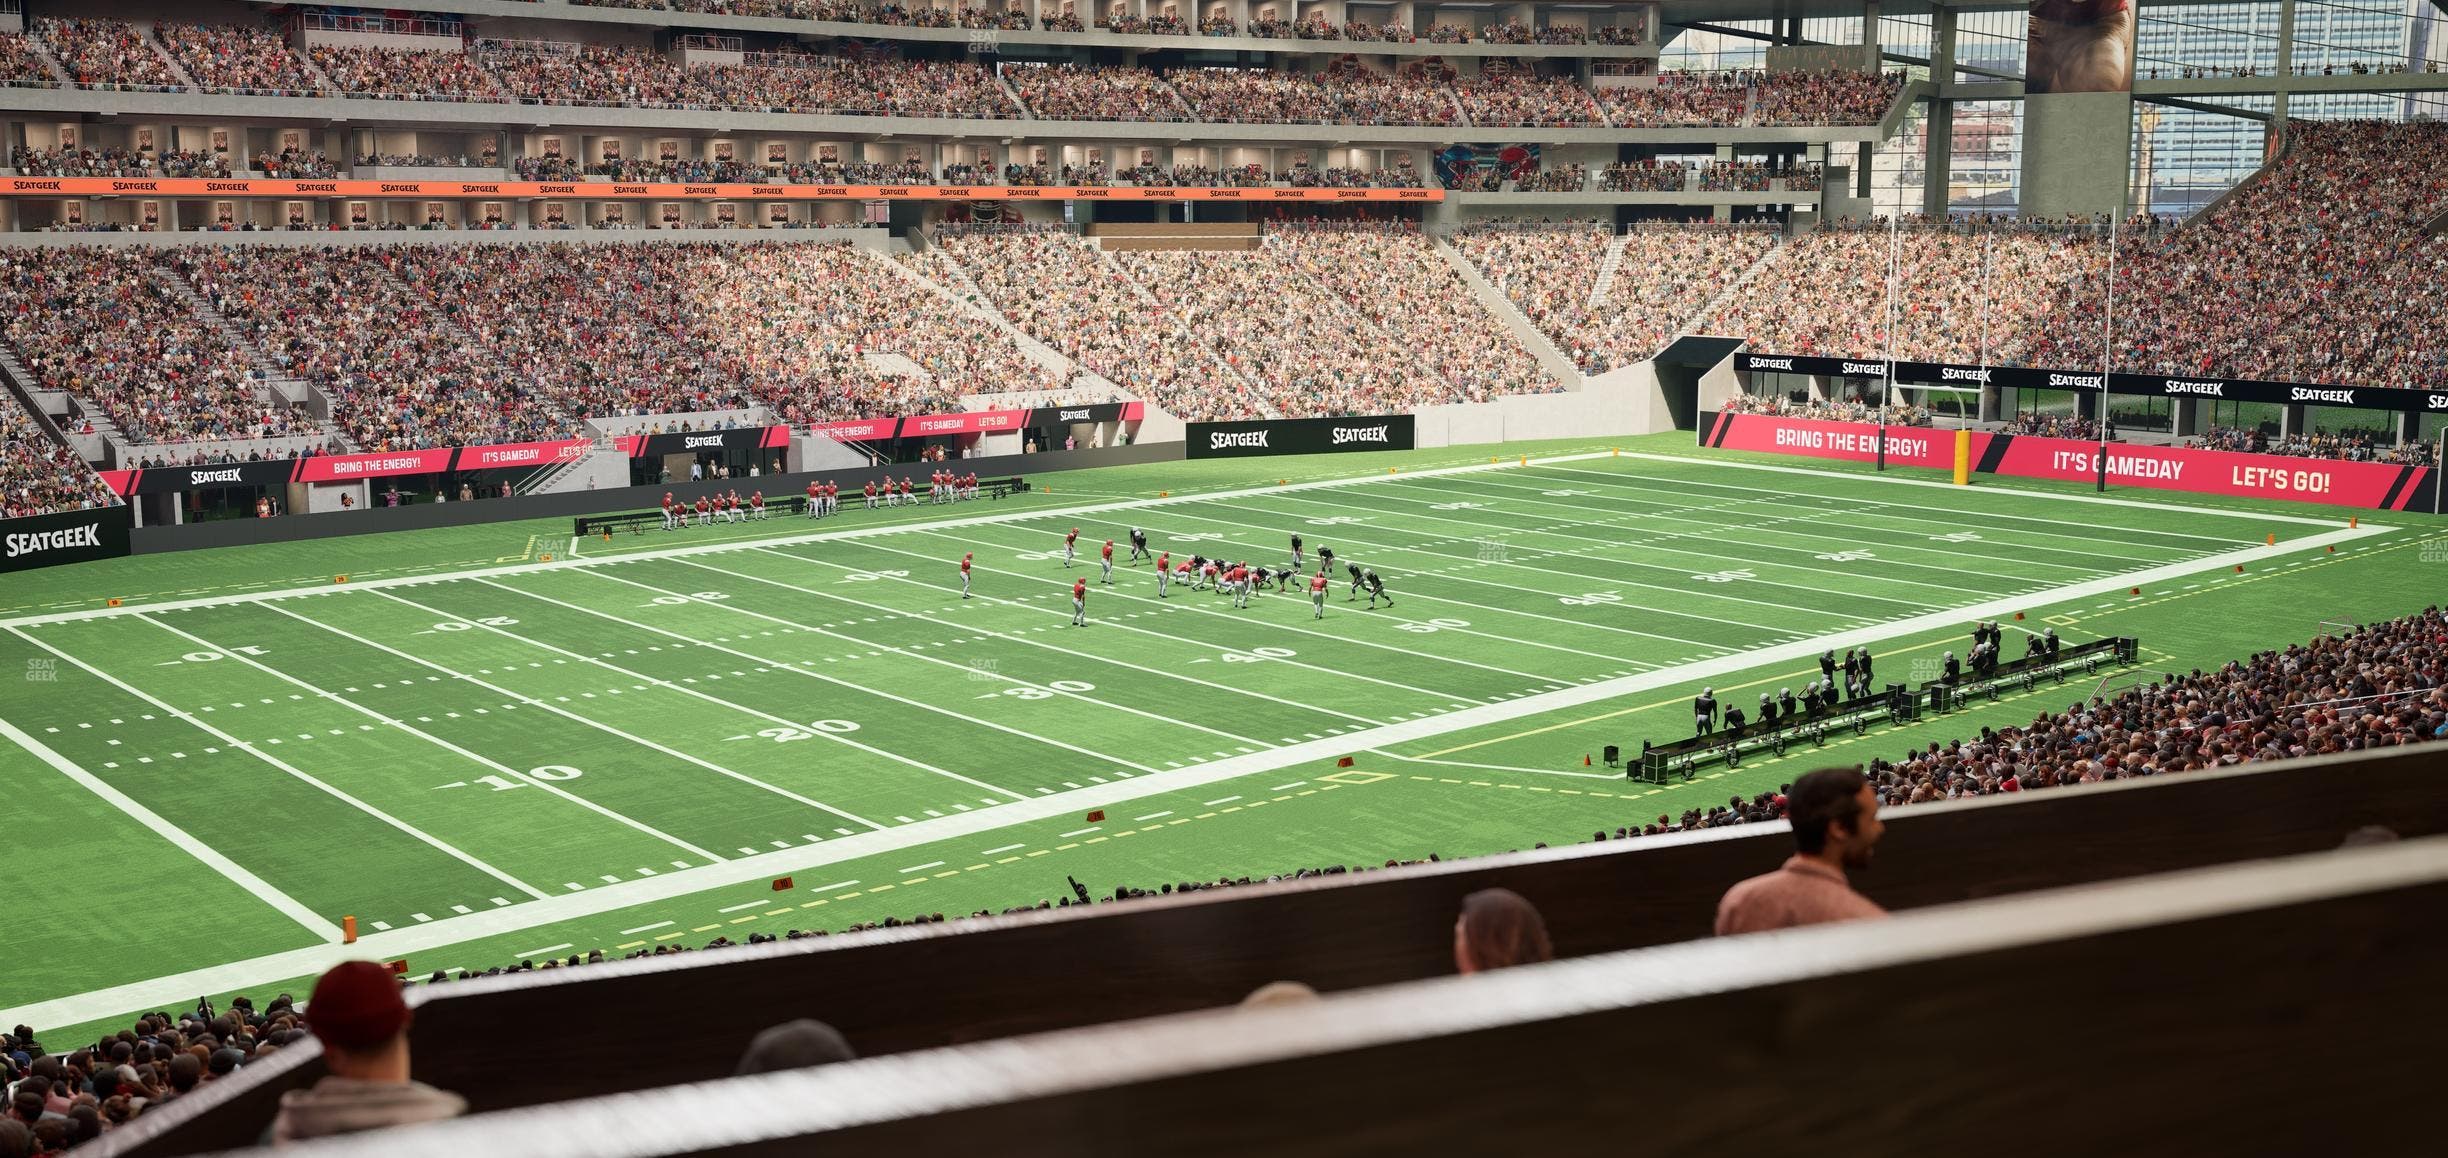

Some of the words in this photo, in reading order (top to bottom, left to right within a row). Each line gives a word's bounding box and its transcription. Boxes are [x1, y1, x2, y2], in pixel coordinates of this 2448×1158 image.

[14, 180, 61, 191] SEATGEEK
[113, 181, 157, 192] SEATGEEK
[207, 182, 249, 192] SEATGEEK
[296, 183, 336, 193] SEATGEEK
[381, 183, 419, 193] SEATGEEK
[463, 184, 499, 194] SEATGEEK
[540, 185, 575, 194] SEATGEEK
[614, 185, 647, 195] SEATGEEK
[685, 186, 716, 195] SEATGEEK
[752, 187, 783, 196] SEATGEEK
[818, 187, 847, 196] SEATGEEK
[880, 188, 908, 196] SEATGEEK
[940, 188, 969, 197] SEATGEEK
[1007, 189, 1038, 197] SEATGEEK
[1077, 189, 1108, 197] SEATGEEK
[1144, 189, 1175, 197] SEATGEEK
[1210, 189, 1240, 198] SEATGEEK
[1275, 190, 1304, 198] SEATGEEK
[1337, 190, 1366, 198] SEATGEEK
[1400, 190, 1428, 198] SEATGEEK
[1750, 357, 1792, 370] SEATGEEK
[1942, 368, 1991, 382] SEATGEEK
[2049, 374, 2103, 389] SEATGEEK
[2165, 380, 2224, 396] SEATGEEK
[2291, 387, 2355, 404] SEATGEEK
[1060, 409, 1090, 421] SEATGEEK
[685, 434, 724, 449] SEATGEEK
[1210, 430, 1269, 450] SEATGEEK
[1332, 425, 1388, 444] SEATGEEK
[1776, 428, 1823, 449] BRING
[1826, 432, 1856, 451] THE
[1858, 435, 1927, 458] ENERGY!
[334, 461, 362, 474] BRING
[365, 459, 382, 472] THE
[383, 457, 421, 470] ENERGY!
[482, 451, 499, 463] IT'S
[500, 448, 540, 462] GAMEDAY
[190, 468, 242, 485] SEATGEEK
[2053, 451, 2088, 472] IT'S
[2232, 466, 2288, 490] LET'S
[2293, 471, 2331, 493] GO!
[6, 523, 101, 557] SEATGEEK
[1222, 647, 1297, 663] 40
[1003, 680, 1096, 700] 30
[757, 719, 861, 743] 20
[473, 765, 583, 792] 10
